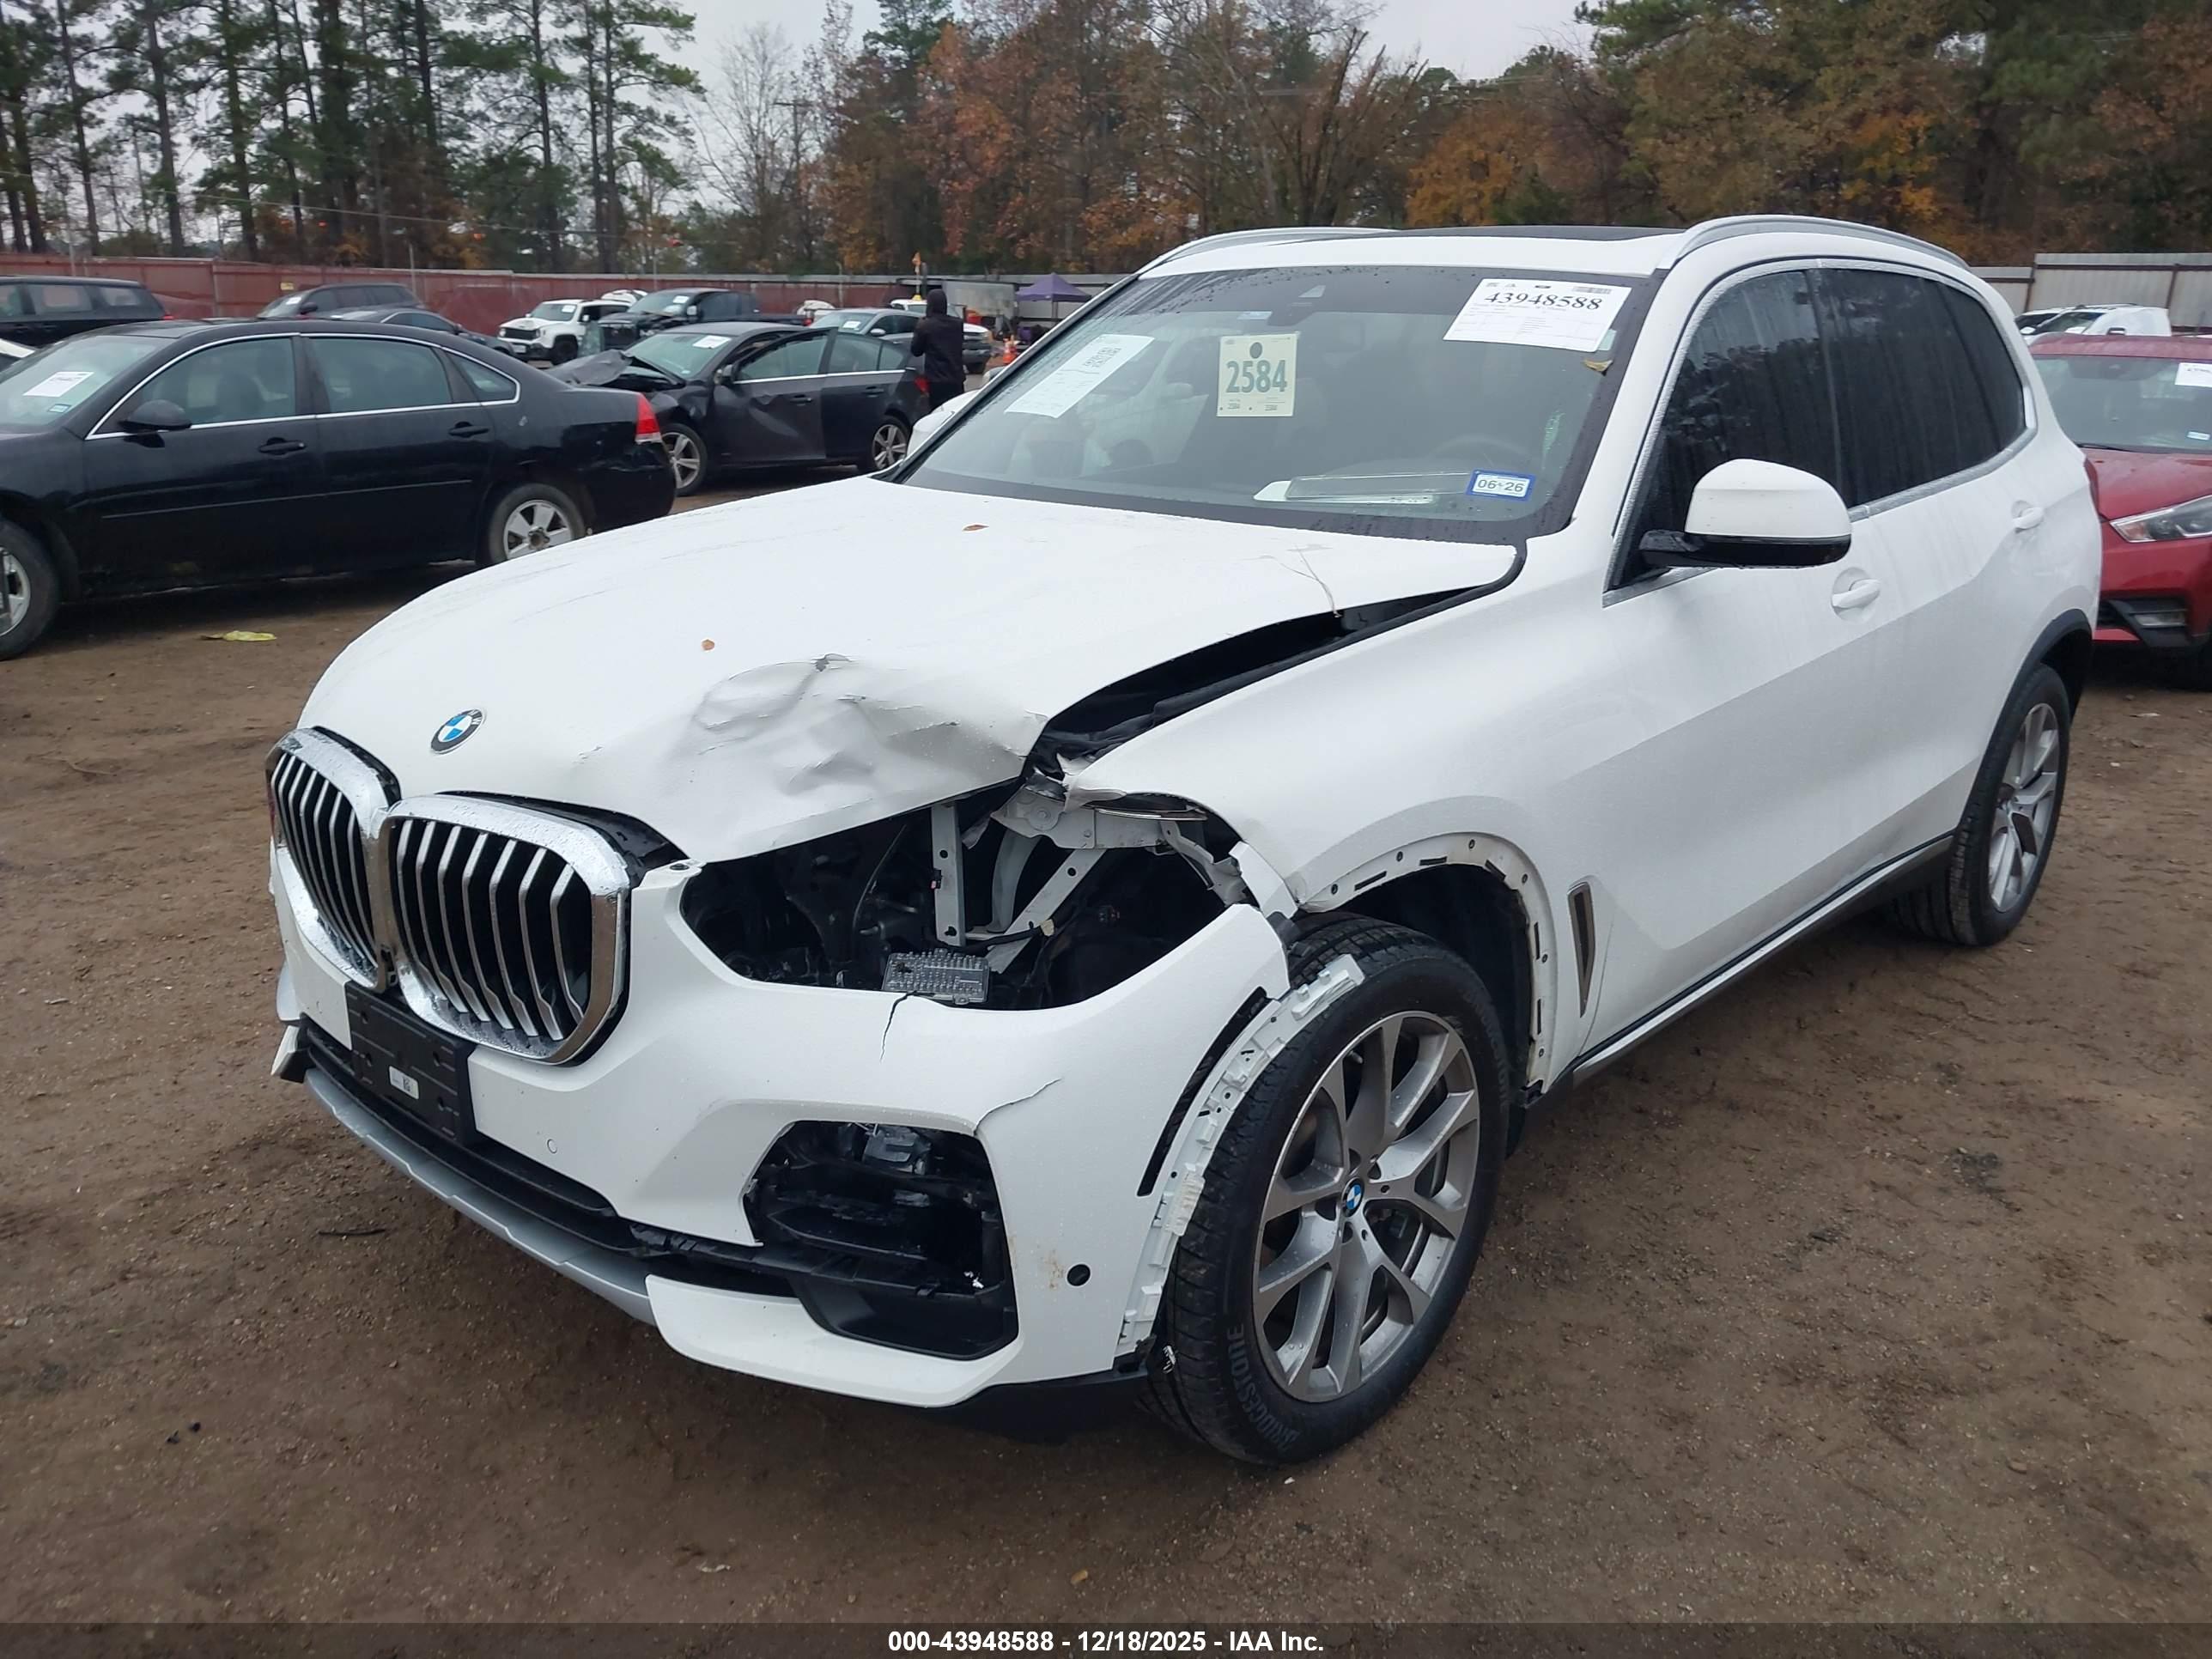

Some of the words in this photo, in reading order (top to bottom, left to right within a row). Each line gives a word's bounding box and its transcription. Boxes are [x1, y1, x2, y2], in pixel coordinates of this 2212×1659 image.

[1485, 292, 1603, 310] 43948588
[1225, 360, 1288, 393] 2584
[1226, 1323, 1301, 1452] BRIDGESTONE
